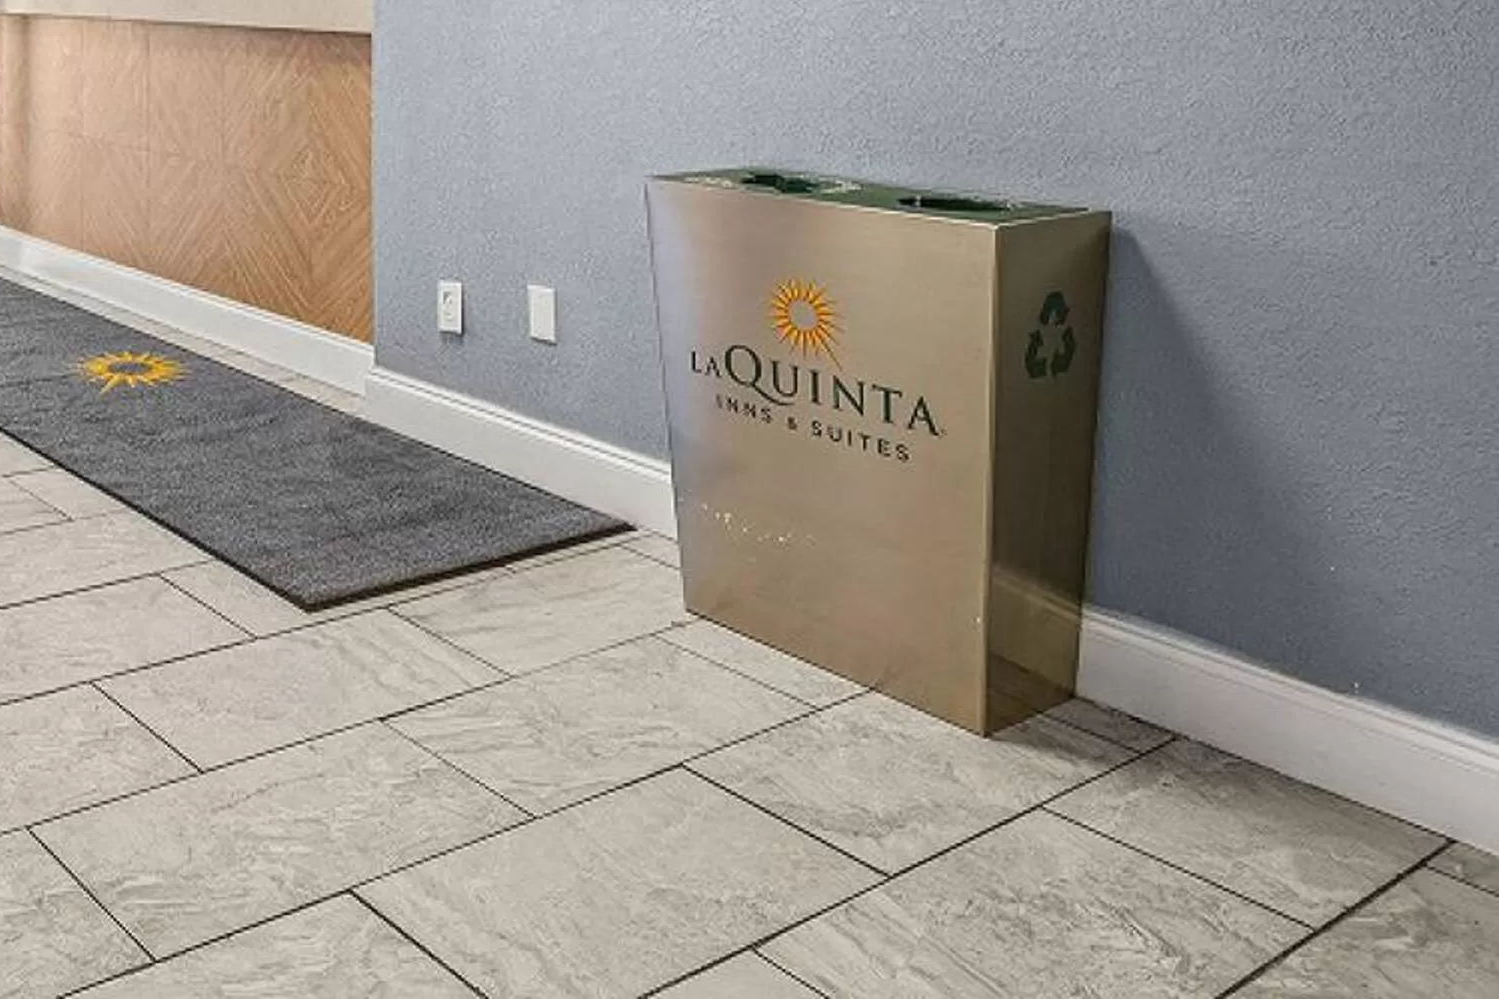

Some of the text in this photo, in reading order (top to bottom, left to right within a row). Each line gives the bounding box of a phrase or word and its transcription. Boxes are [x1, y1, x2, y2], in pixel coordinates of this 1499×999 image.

[715, 394, 911, 464] INNS & SUITES
